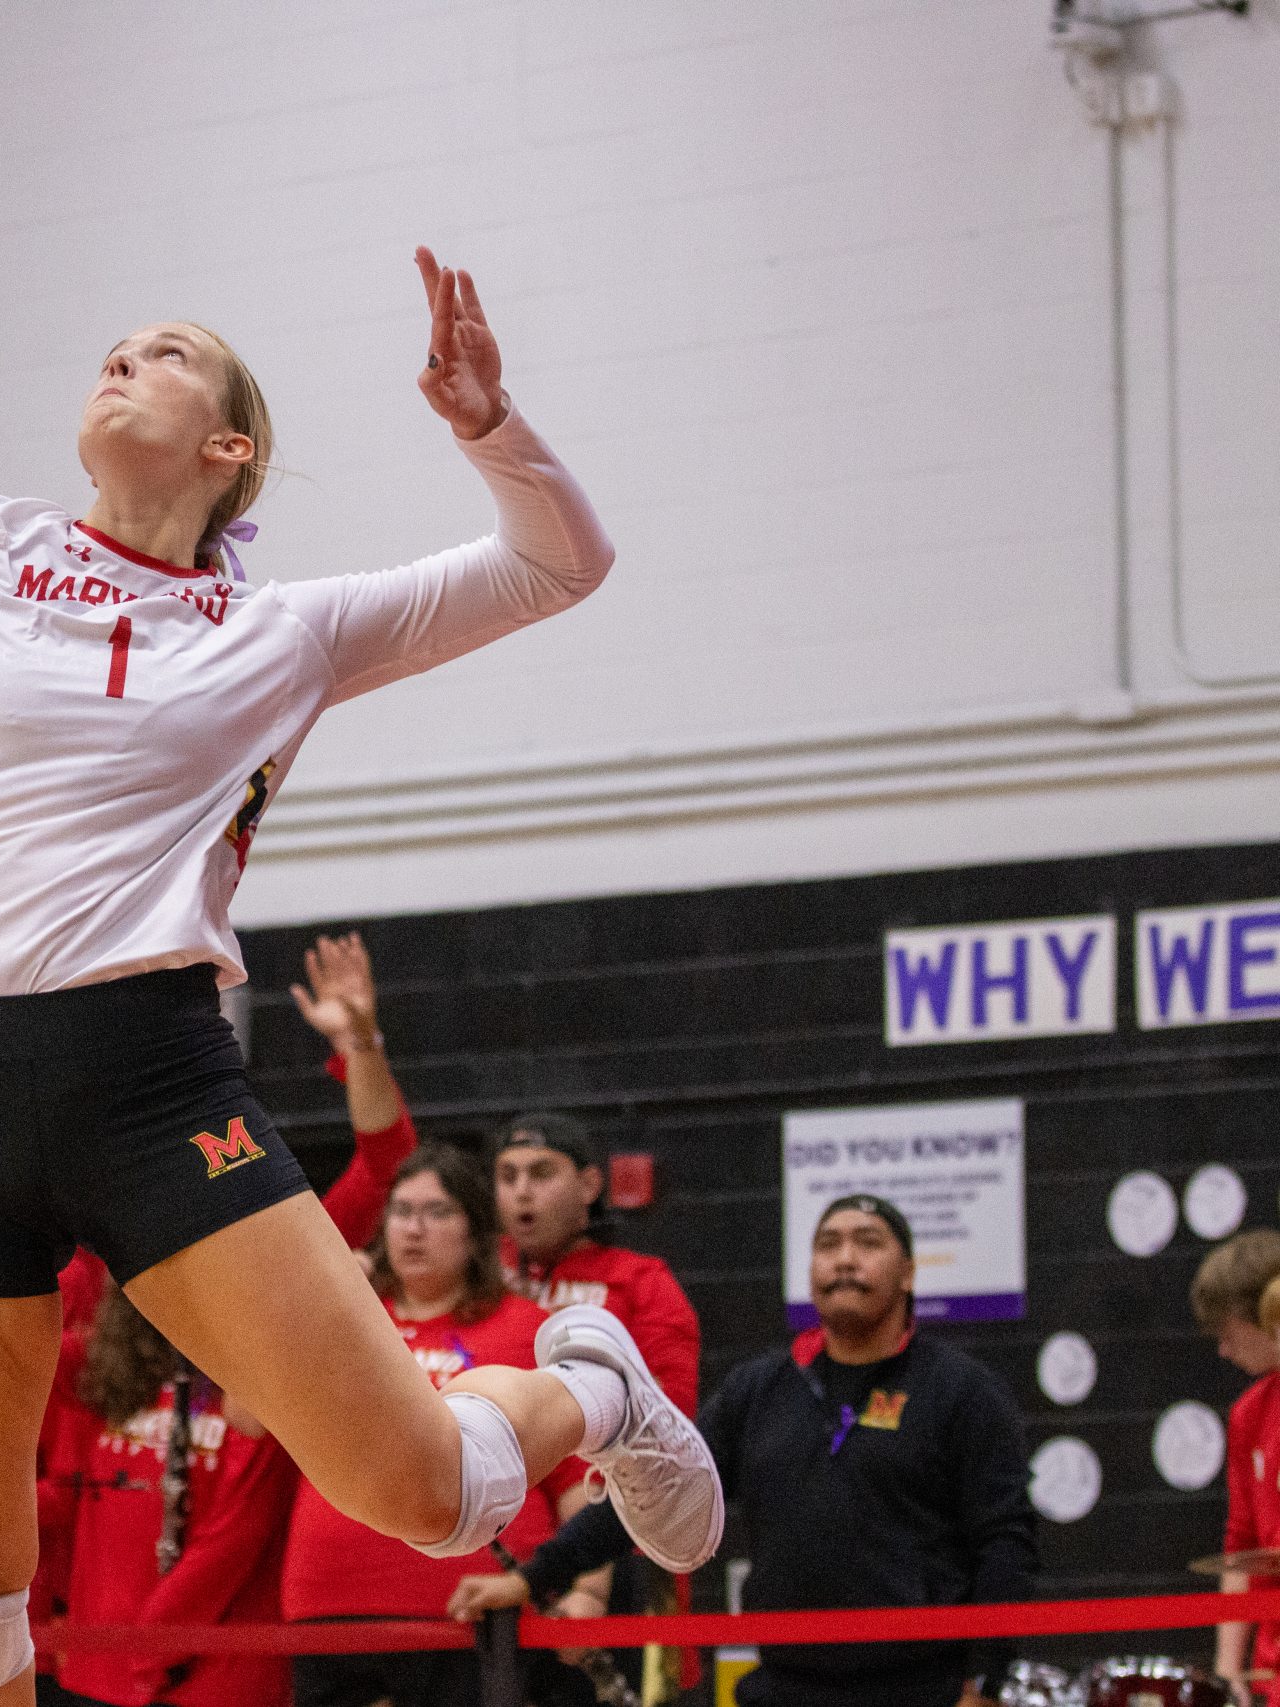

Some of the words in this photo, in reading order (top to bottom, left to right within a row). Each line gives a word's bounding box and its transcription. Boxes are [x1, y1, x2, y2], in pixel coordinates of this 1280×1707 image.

[105, 615, 132, 699] 1
[892, 931, 1098, 1032] WHY
[1149, 913, 1280, 1019] WE
[188, 1115, 264, 1177] M
[783, 1139, 840, 1169] DID
[846, 1137, 907, 1165] YOU
